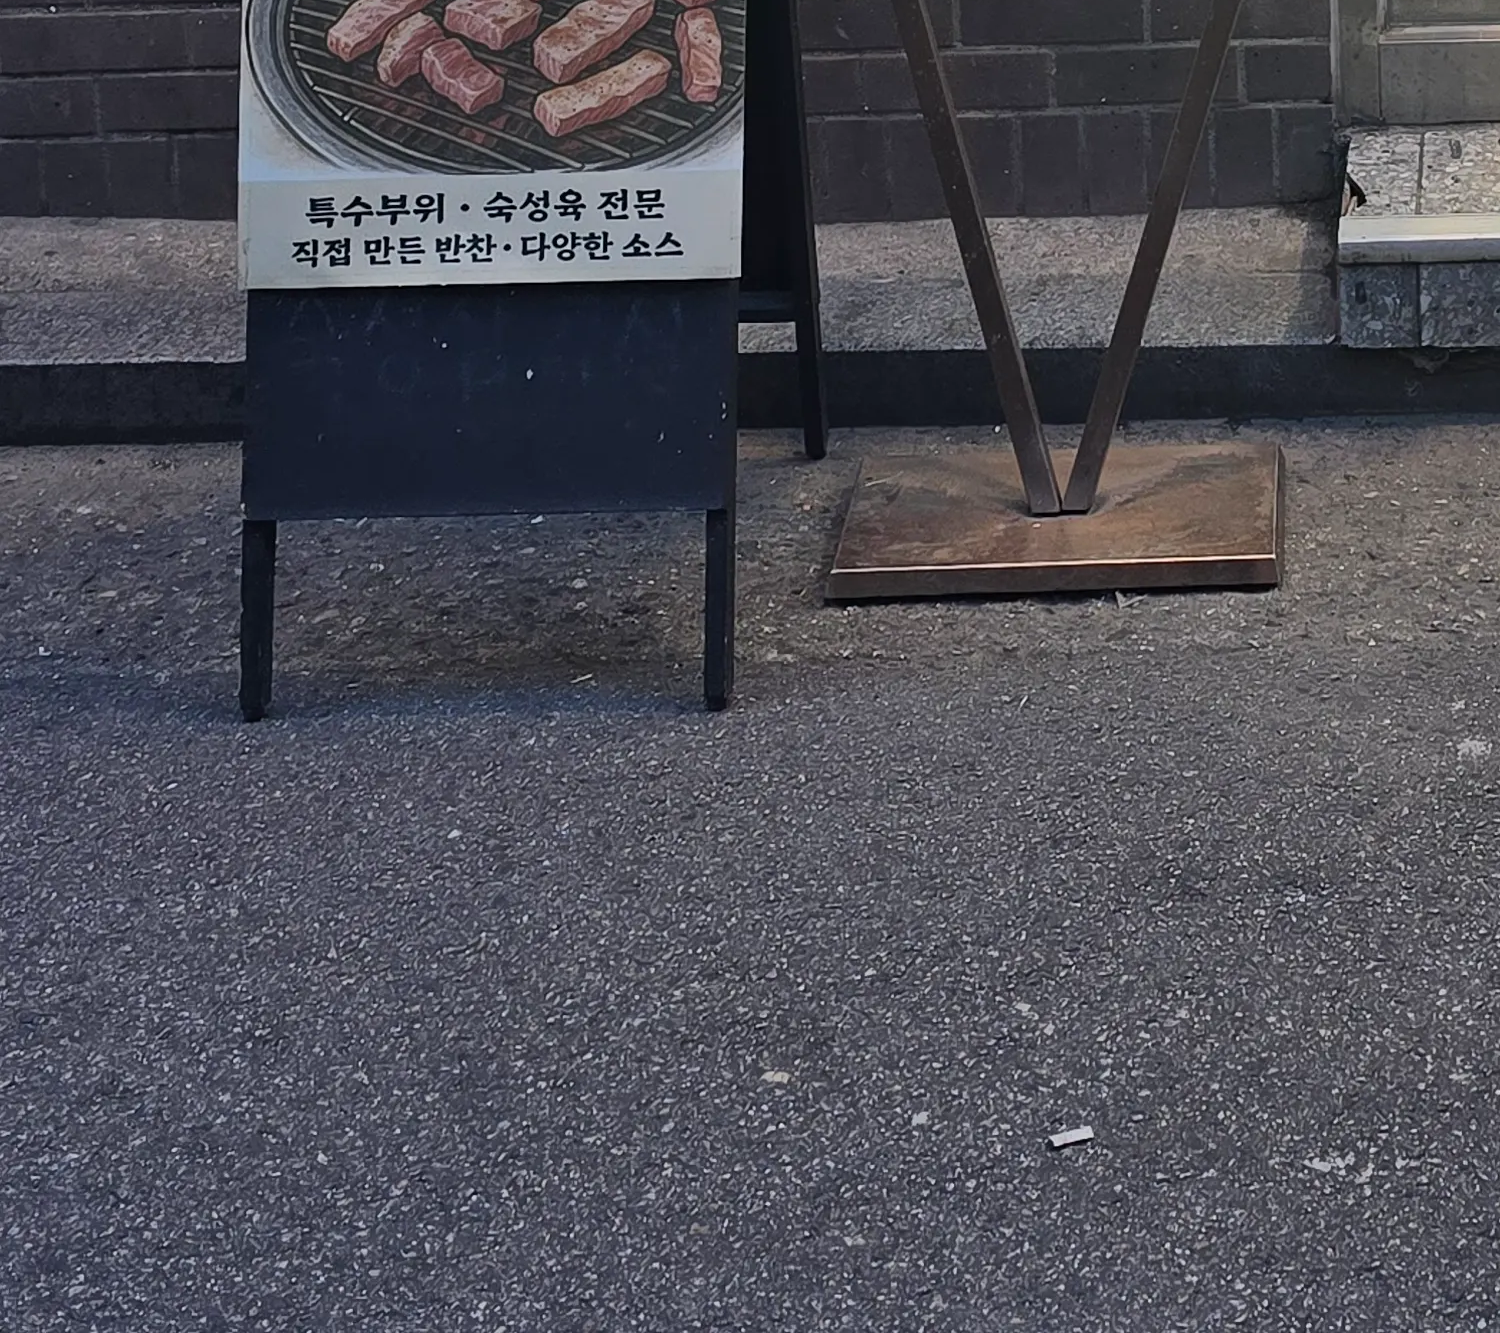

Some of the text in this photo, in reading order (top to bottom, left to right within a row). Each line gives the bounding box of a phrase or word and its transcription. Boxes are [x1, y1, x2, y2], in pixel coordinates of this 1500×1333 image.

[305, 188, 665, 228] 특수부위 숙성육 전문
[291, 237, 351, 268] 직접
[363, 235, 426, 265] 만든
[622, 232, 684, 259] 소스
